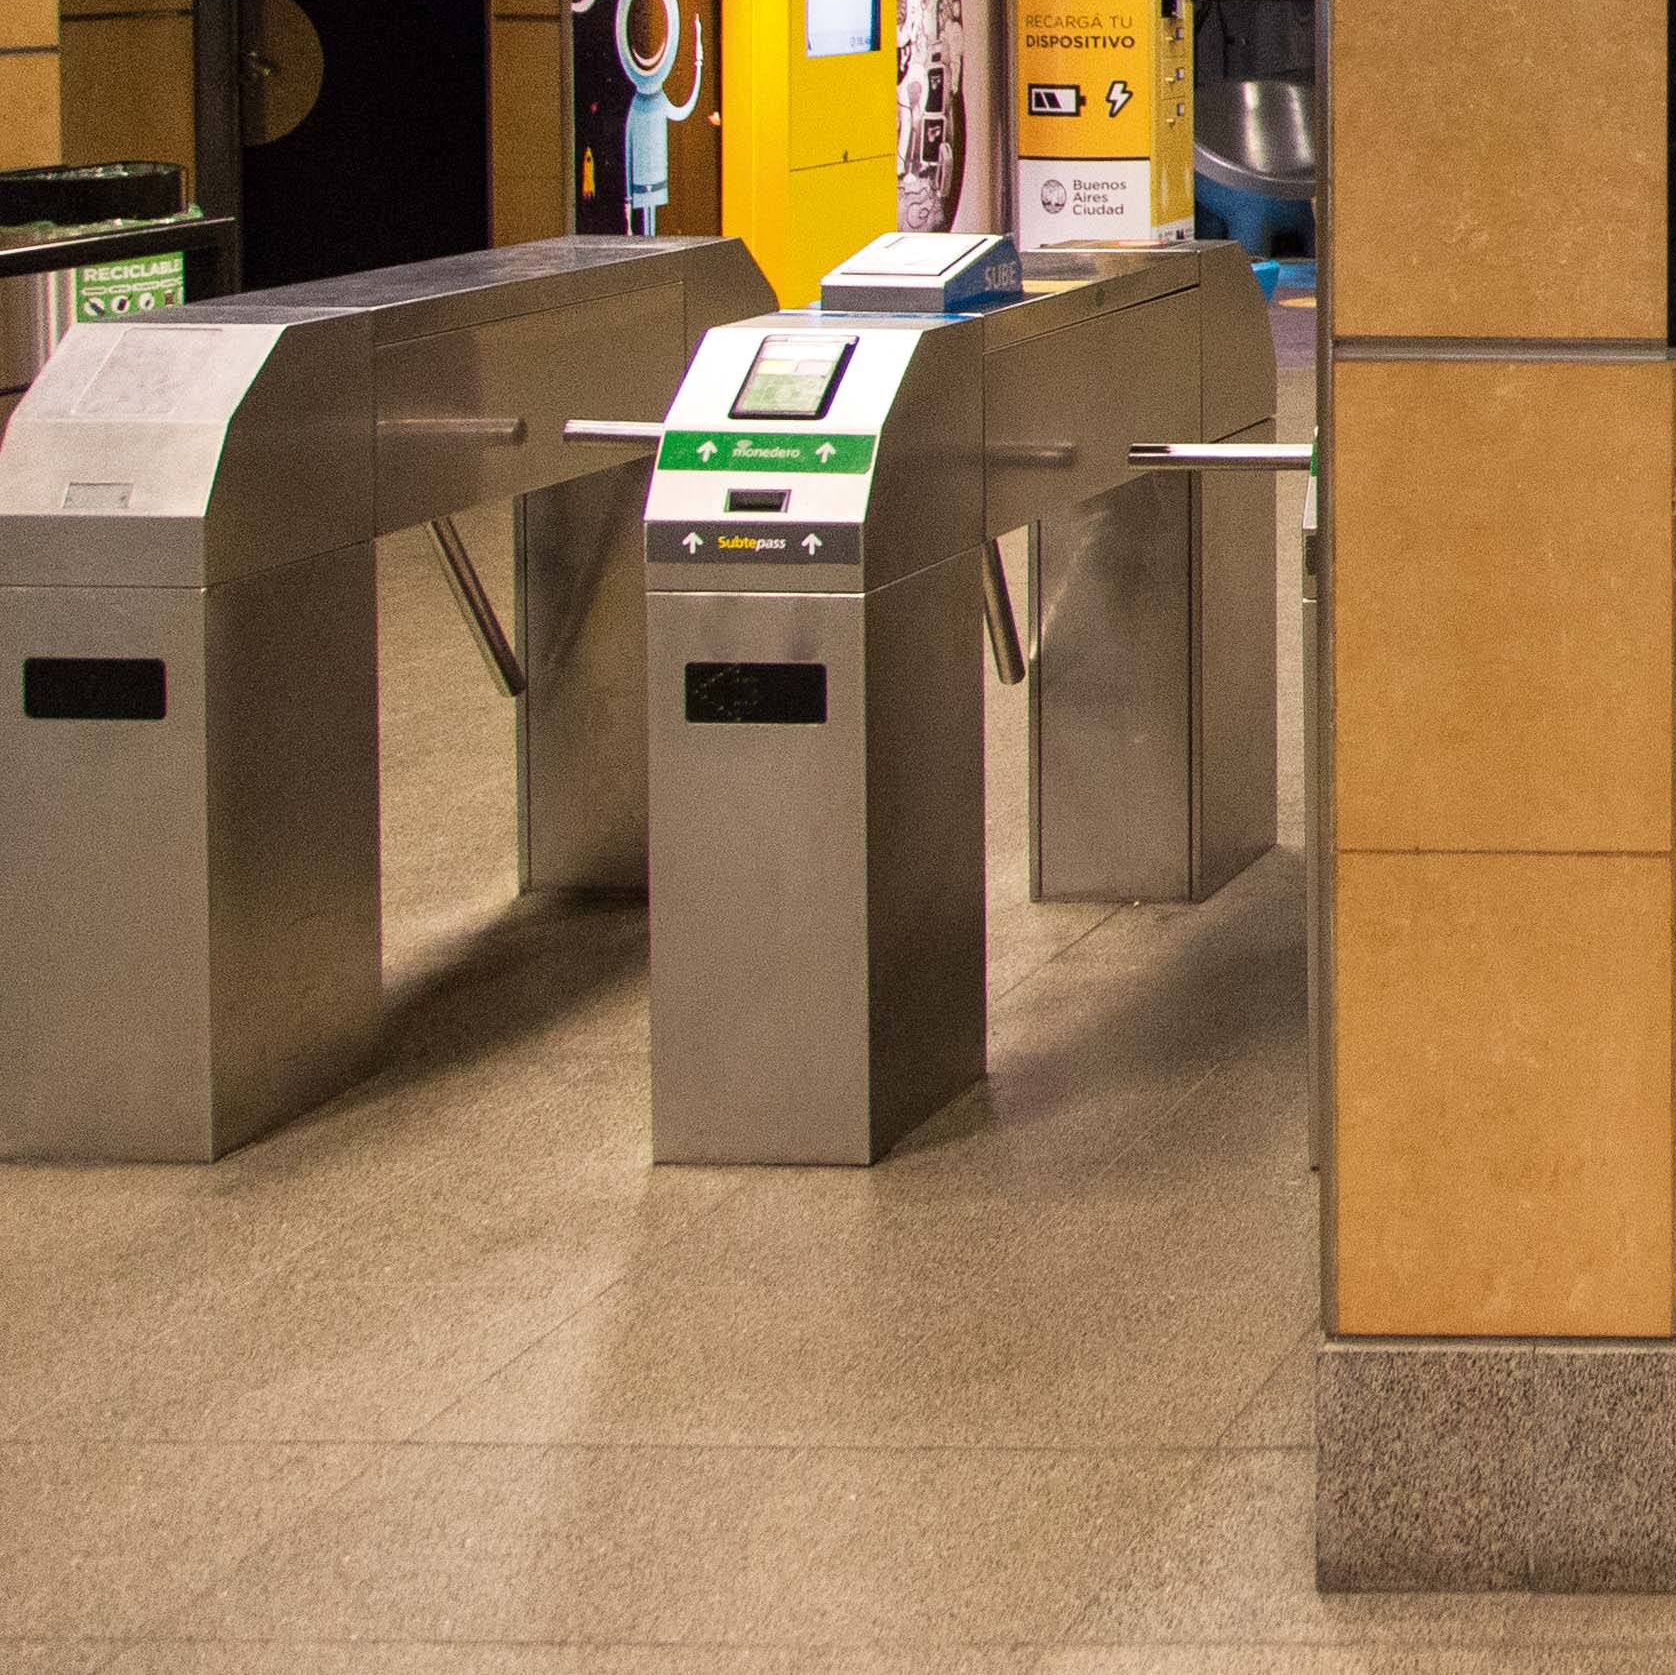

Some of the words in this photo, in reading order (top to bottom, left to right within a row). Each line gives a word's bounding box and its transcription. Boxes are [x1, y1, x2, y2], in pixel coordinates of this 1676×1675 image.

[1024, 13, 1103, 29] RECARGÁ
[1110, 17, 1133, 29] TU
[1025, 35, 1136, 49] DISPOSITIVO
[1072, 179, 1127, 191] Buenos
[1072, 191, 1109, 203] Aires
[1072, 203, 1125, 216] Ciudad
[983, 262, 1016, 291] SUBE
[731, 445, 802, 460] monedero
[717, 535, 787, 552] Subtepass
